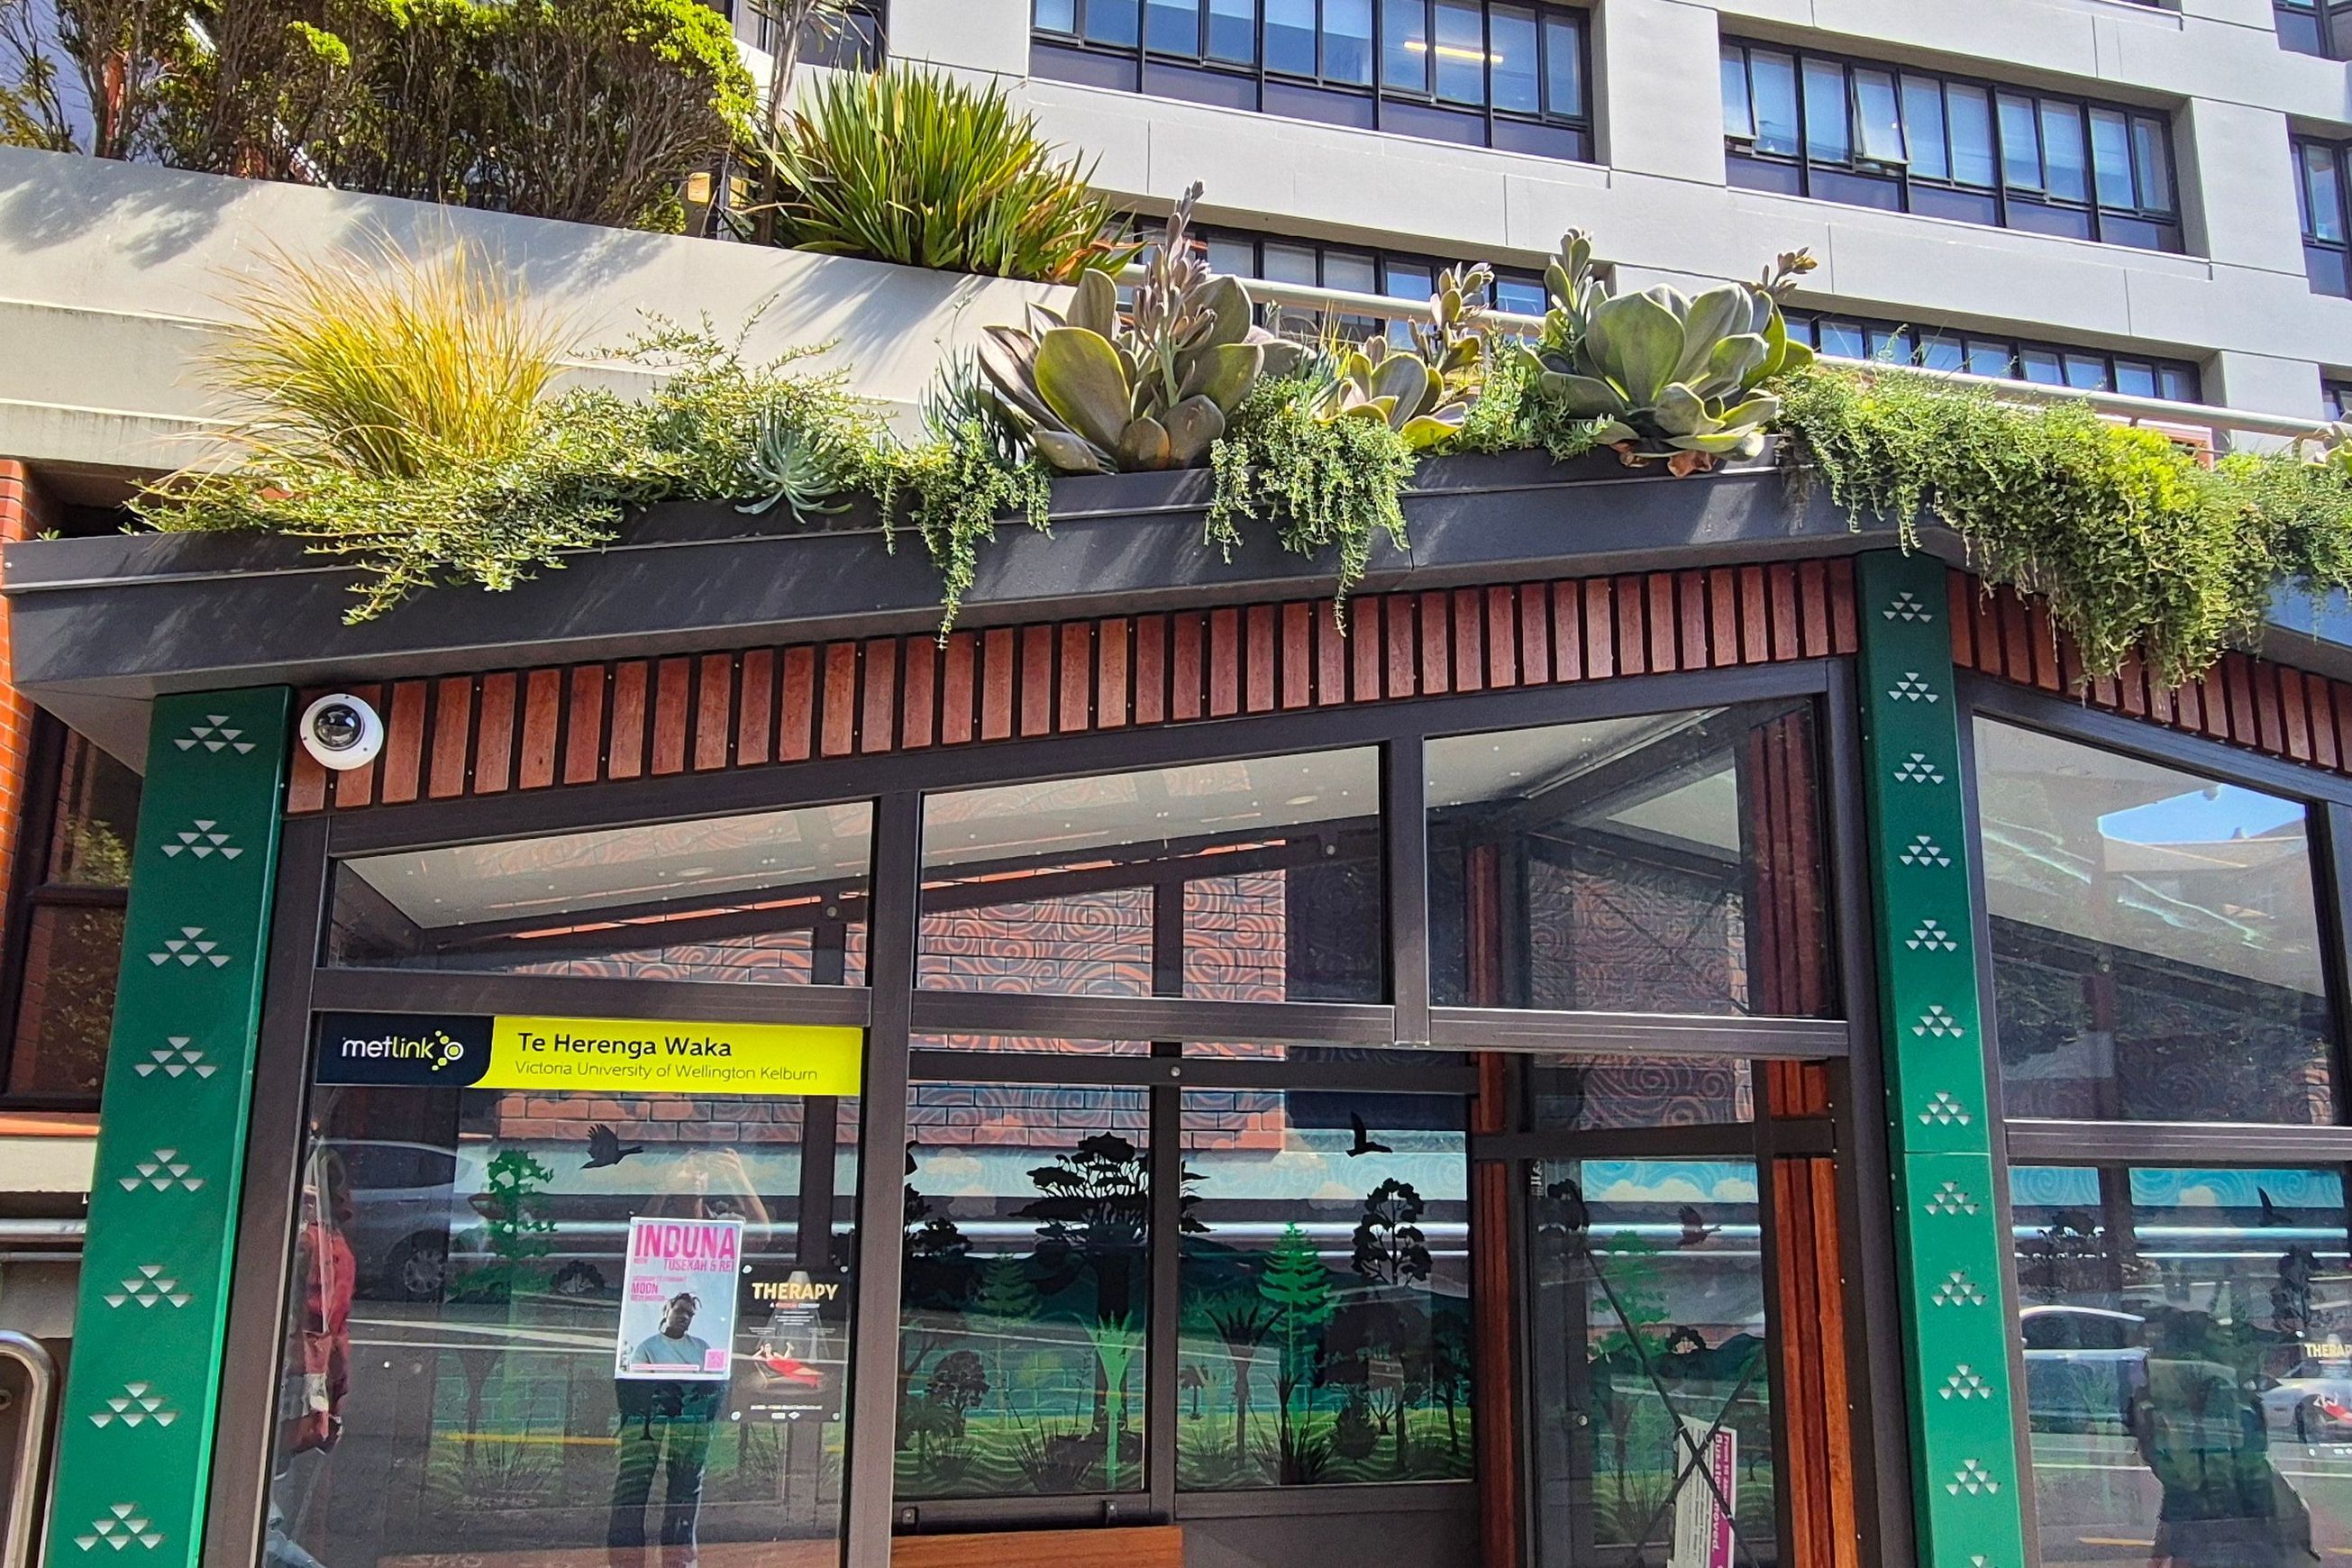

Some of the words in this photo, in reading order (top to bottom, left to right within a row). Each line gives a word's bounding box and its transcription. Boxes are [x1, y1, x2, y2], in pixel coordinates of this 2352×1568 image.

[342, 1036, 434, 1059] metlink
[517, 1032, 546, 1052] Te
[554, 1034, 657, 1060] Herenga
[665, 1036, 732, 1056] Waka
[515, 1060, 572, 1076] Victoria
[578, 1062, 652, 1080] University
[656, 1063, 672, 1078] of
[675, 1064, 756, 1082] Wellington
[761, 1067, 818, 1080] Kelburn
[634, 1225, 735, 1259] INDUNA
[632, 1282, 658, 1294] MOON
[752, 1282, 839, 1300] THERAPY
